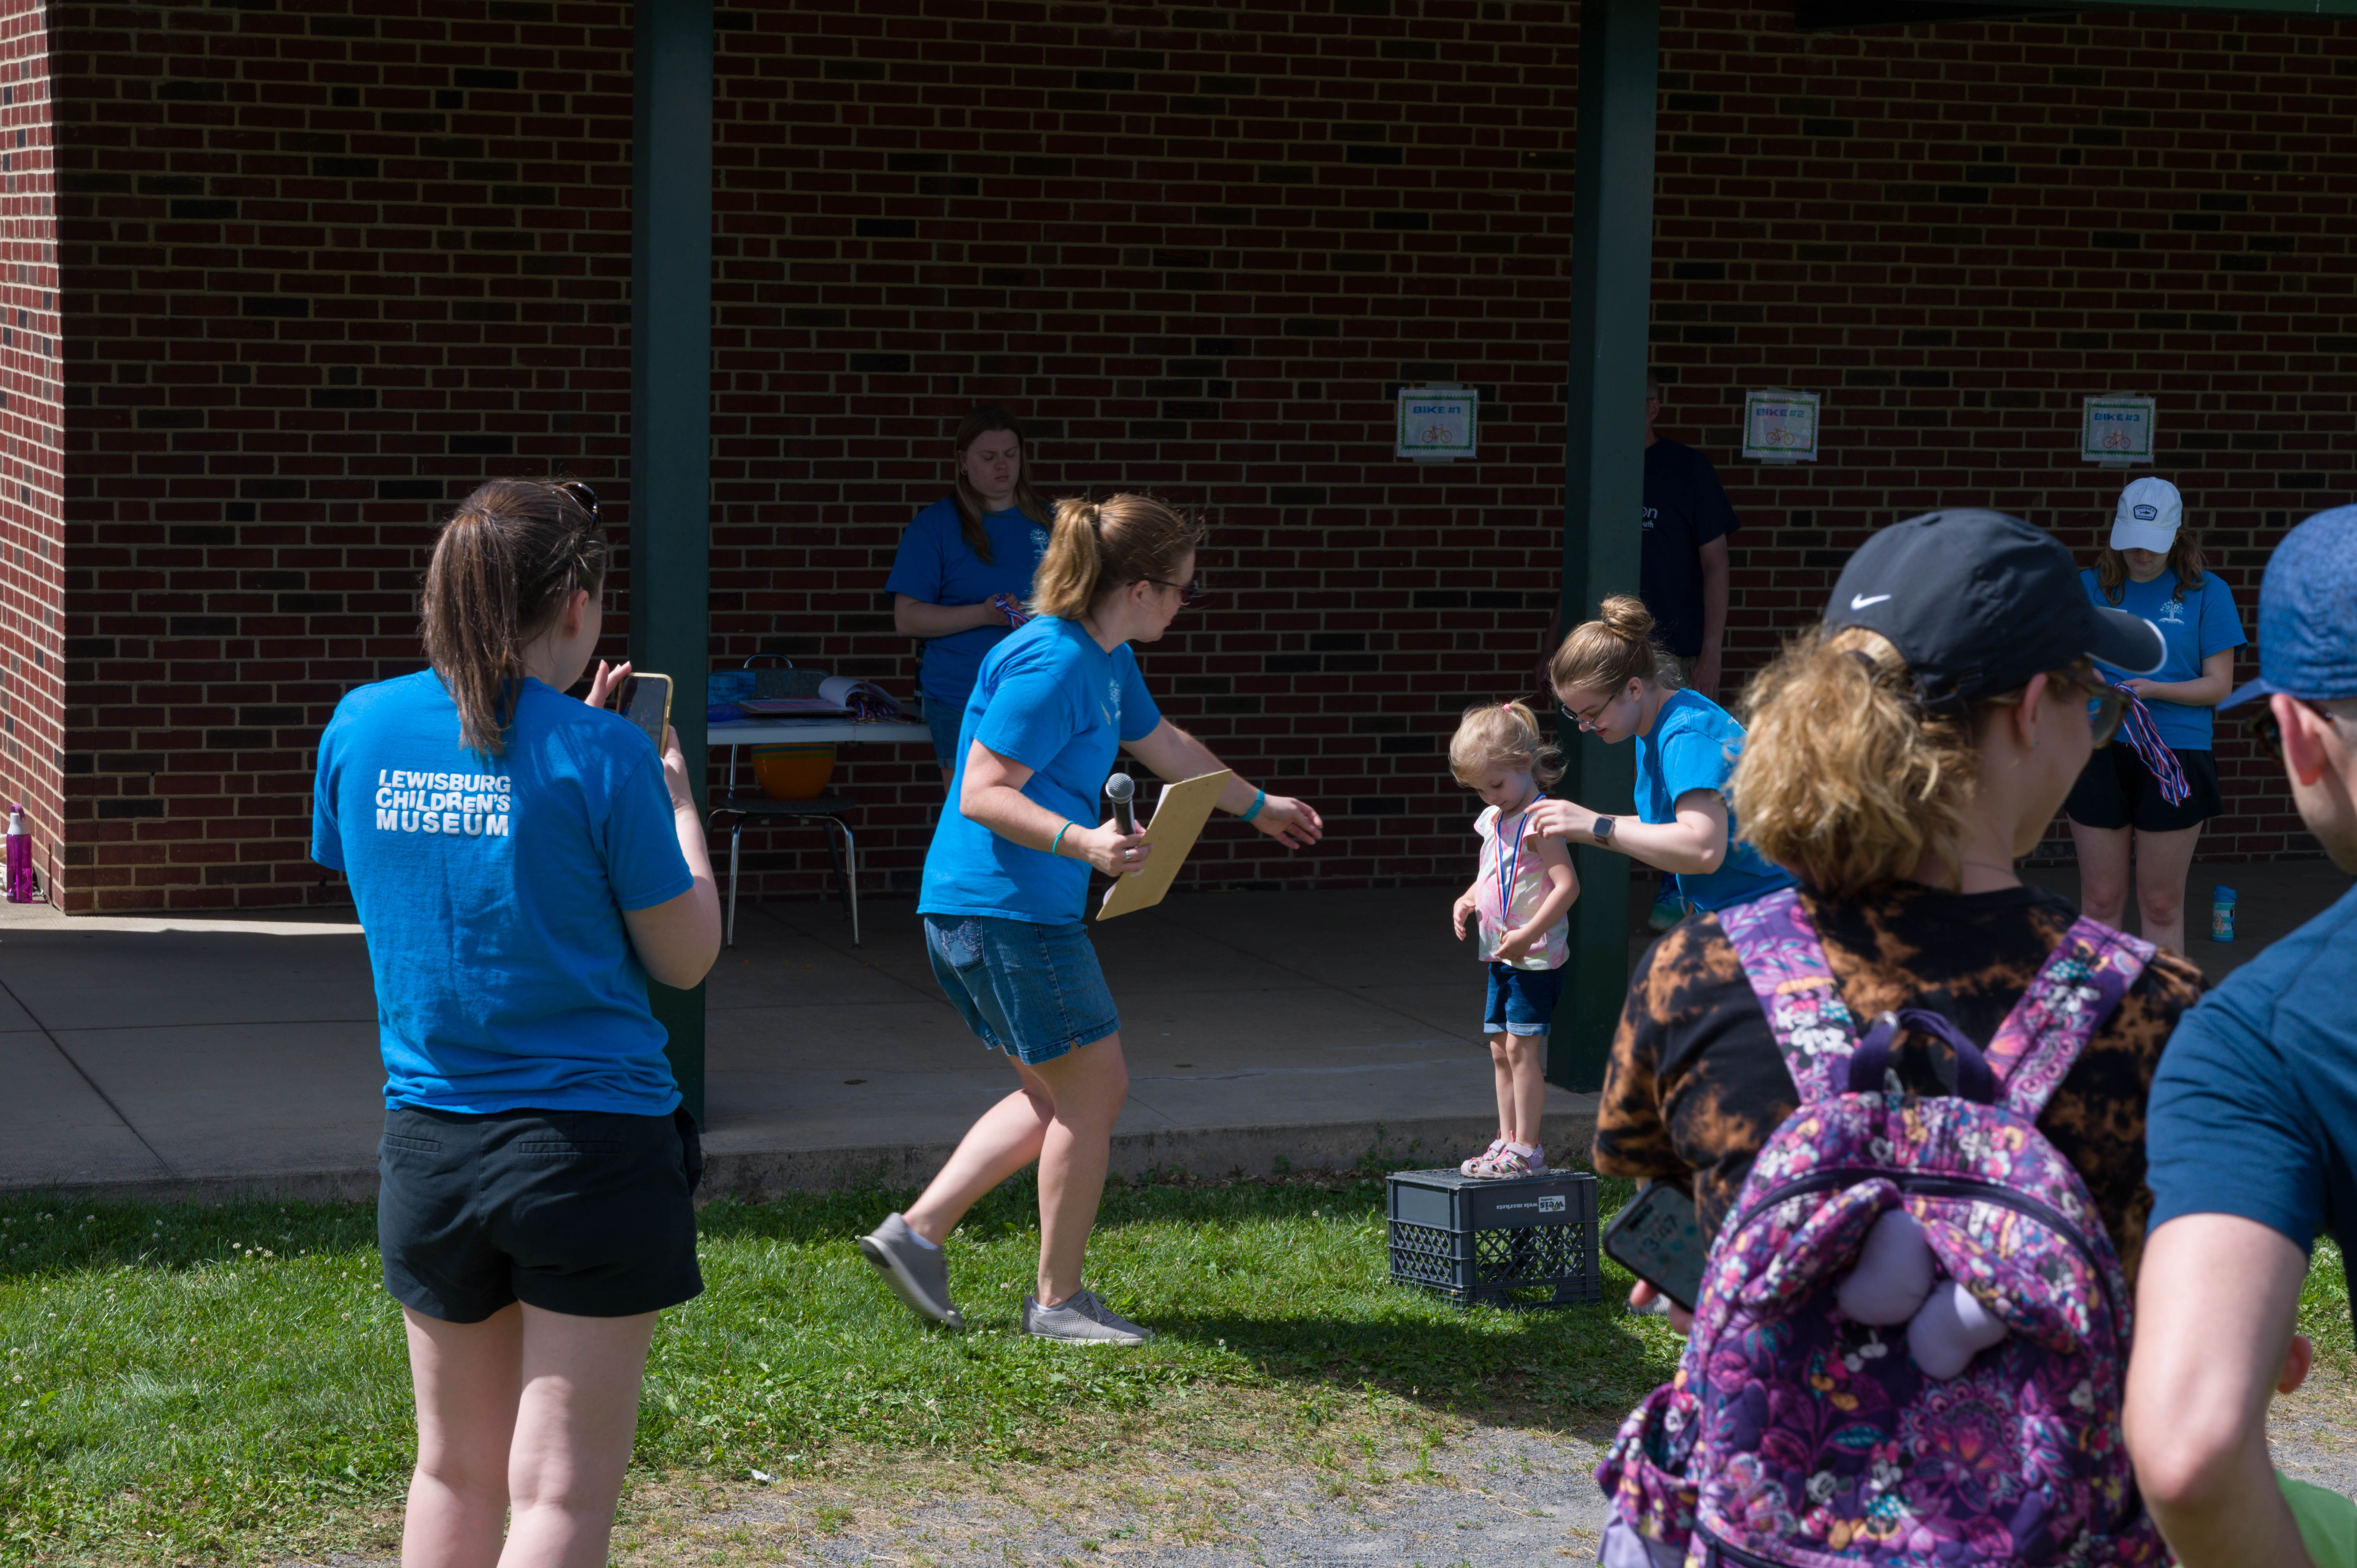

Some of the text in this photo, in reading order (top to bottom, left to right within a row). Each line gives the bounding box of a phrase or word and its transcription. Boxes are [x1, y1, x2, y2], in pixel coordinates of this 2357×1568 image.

[1757, 408, 1787, 417] BIKE
[379, 769, 511, 793] LEWISBURG
[376, 788, 511, 813] CHILDREN'S
[376, 809, 508, 836] MUSEUM
[1540, 1201, 1564, 1210] weis
